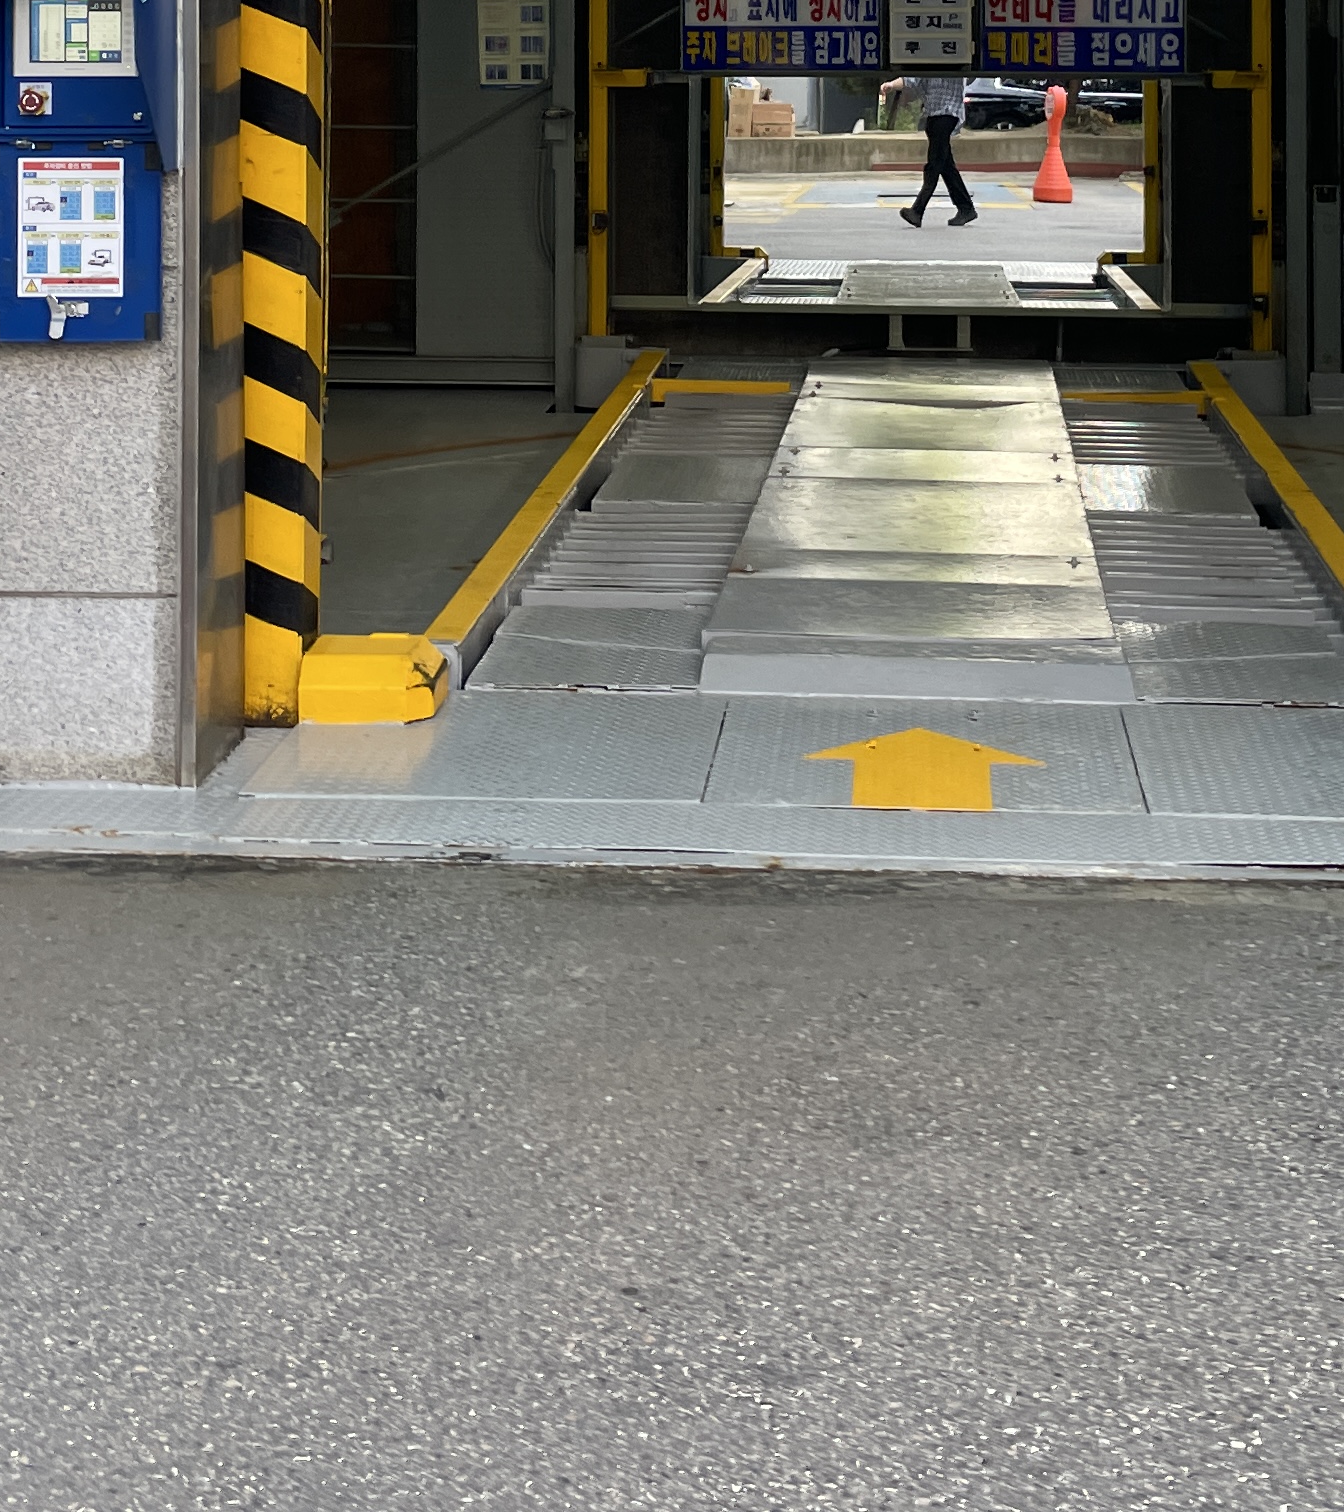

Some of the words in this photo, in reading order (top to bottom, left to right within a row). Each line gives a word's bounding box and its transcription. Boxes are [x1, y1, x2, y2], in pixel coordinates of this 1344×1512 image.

[905, 15, 942, 29] 정지
[686, 30, 717, 65] 주차
[726, 30, 805, 65] 브레이크를
[814, 30, 878, 65] 잠그세요
[987, 31, 1076, 66] 백미러를
[1091, 31, 1180, 66] 접으세요
